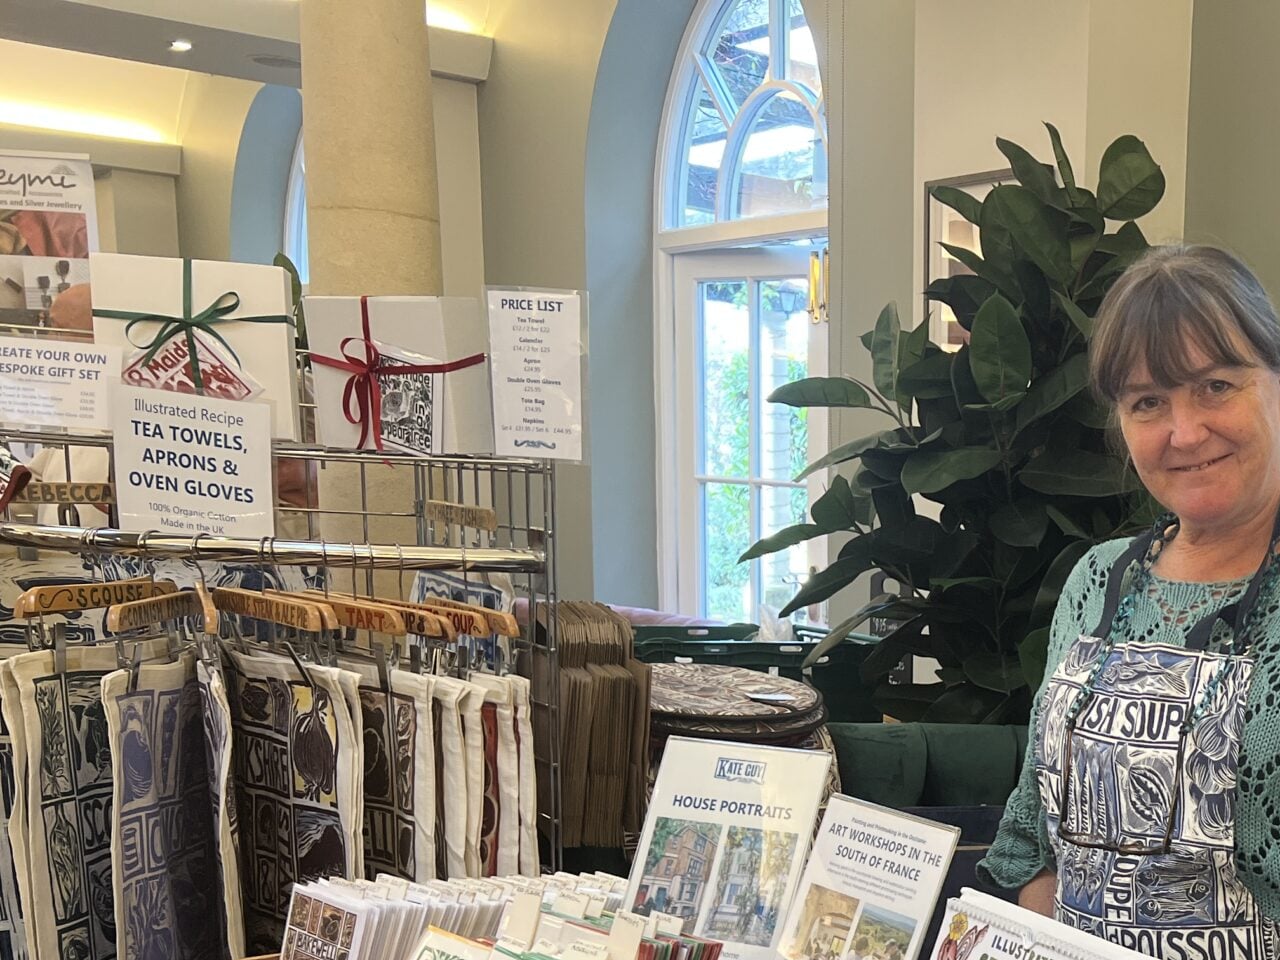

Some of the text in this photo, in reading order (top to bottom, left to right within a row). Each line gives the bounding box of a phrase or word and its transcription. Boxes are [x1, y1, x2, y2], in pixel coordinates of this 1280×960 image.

[501, 298, 563, 312] PRICE LIST
[36, 349, 107, 365] YOUR OWN
[48, 367, 101, 381] GIFT SET
[134, 398, 244, 428] Illustrated Recipe
[131, 419, 248, 454] TEA TOWELS,
[142, 447, 239, 476] APRONS &
[129, 471, 254, 503] OVEN GLOVES
[173, 505, 205, 519] Organic
[160, 517, 224, 534] Made the UK
[76, 584, 144, 608] SCOUSE
[345, 607, 385, 633] TART
[1123, 699, 1186, 741] SOUP
[716, 759, 743, 777] KATE
[672, 794, 793, 820] HOUSE PORTRAITS
[828, 822, 943, 868] ART WORKSHOPS IN THE
[835, 844, 868, 865] SOUTH
[868, 855, 882, 869] OF
[882, 859, 921, 882] FRANCE
[297, 930, 337, 960] BAKEWELL
